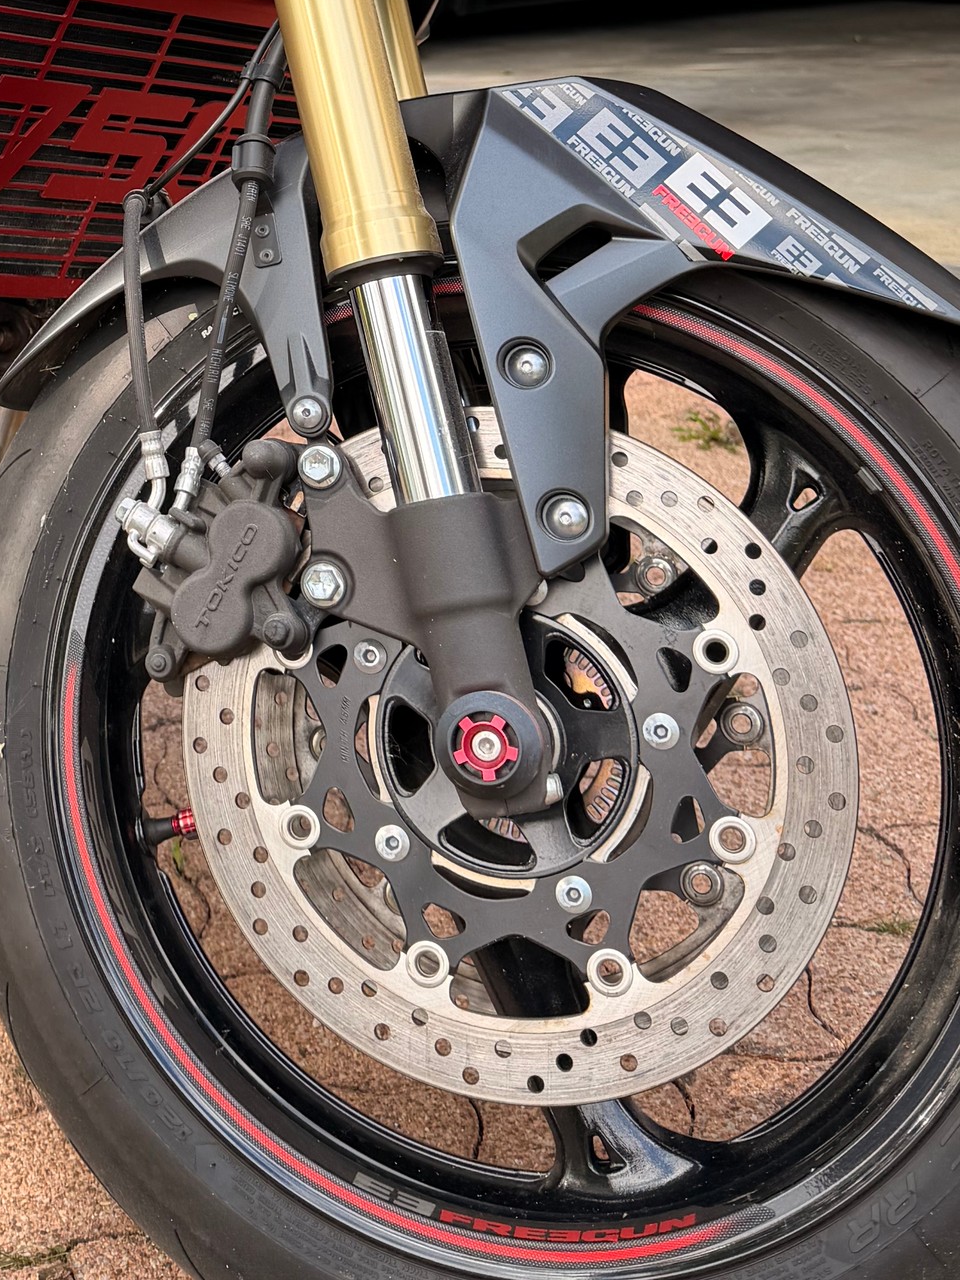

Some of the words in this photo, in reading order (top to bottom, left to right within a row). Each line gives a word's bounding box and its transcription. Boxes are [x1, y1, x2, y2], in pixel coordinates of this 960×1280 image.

[566, 134, 636, 199] FREEGUN
[651, 184, 736, 262] FREEGUN
[785, 207, 860, 274] FREEGUN
[195, 523, 259, 629] TOKICO
[440, 1210, 697, 1243] FREEGUN
